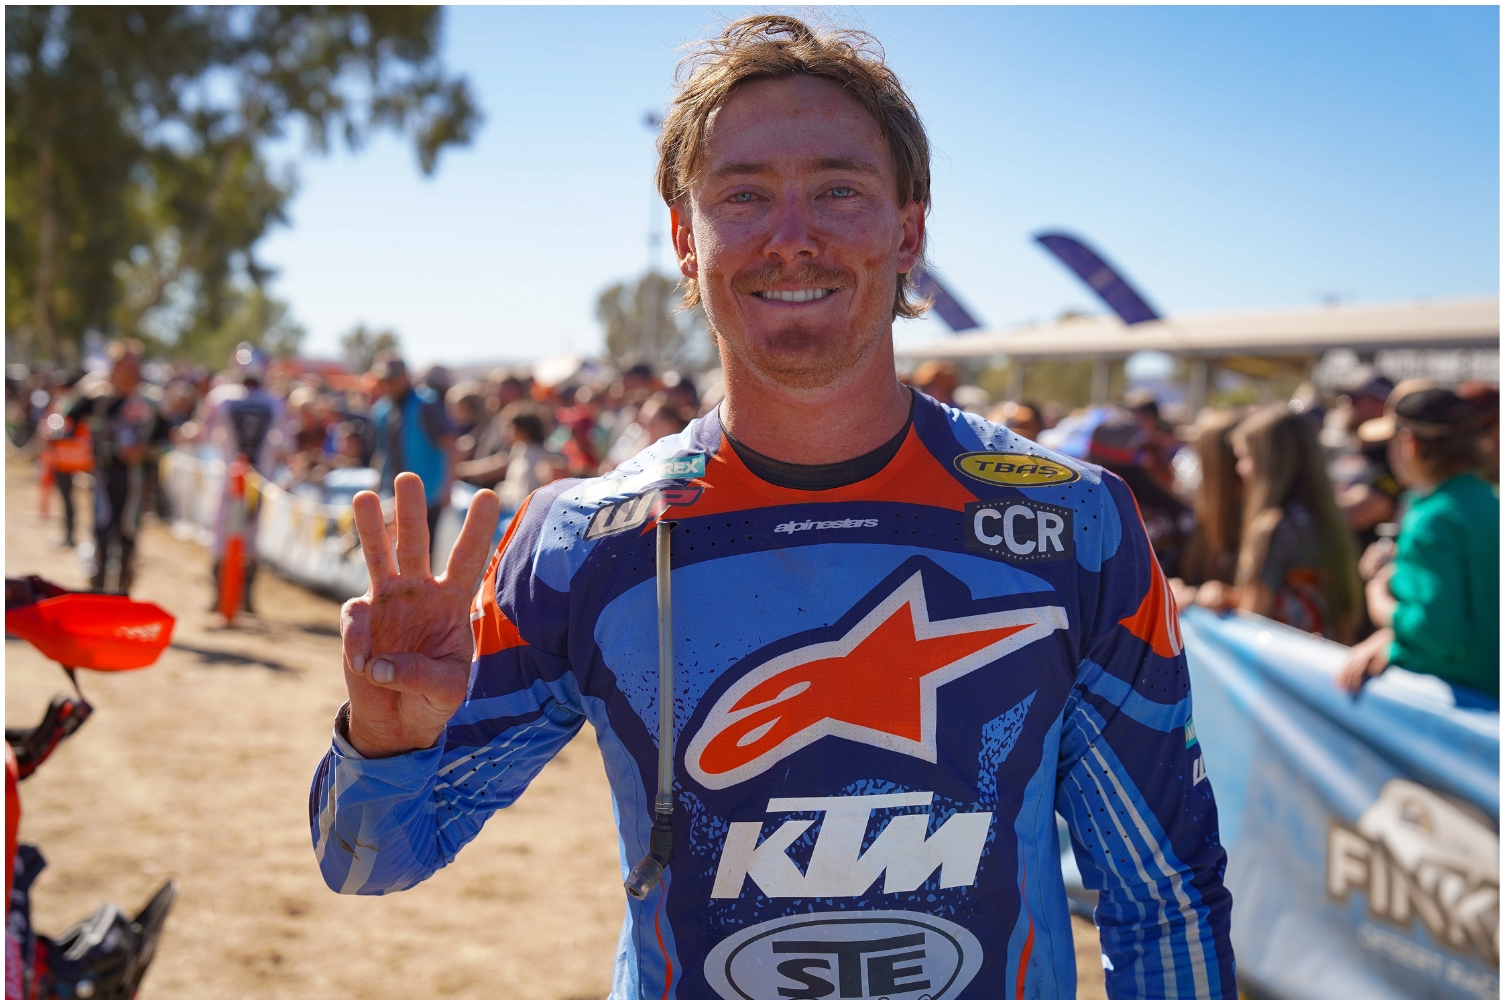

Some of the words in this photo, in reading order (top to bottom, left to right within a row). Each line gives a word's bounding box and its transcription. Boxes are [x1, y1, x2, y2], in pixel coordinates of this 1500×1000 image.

[975, 460, 1060, 475] TBAS
[773, 517, 879, 535] alpinestars
[973, 504, 1065, 555] CCR
[710, 791, 993, 899] KTM
[771, 932, 932, 998] STE
